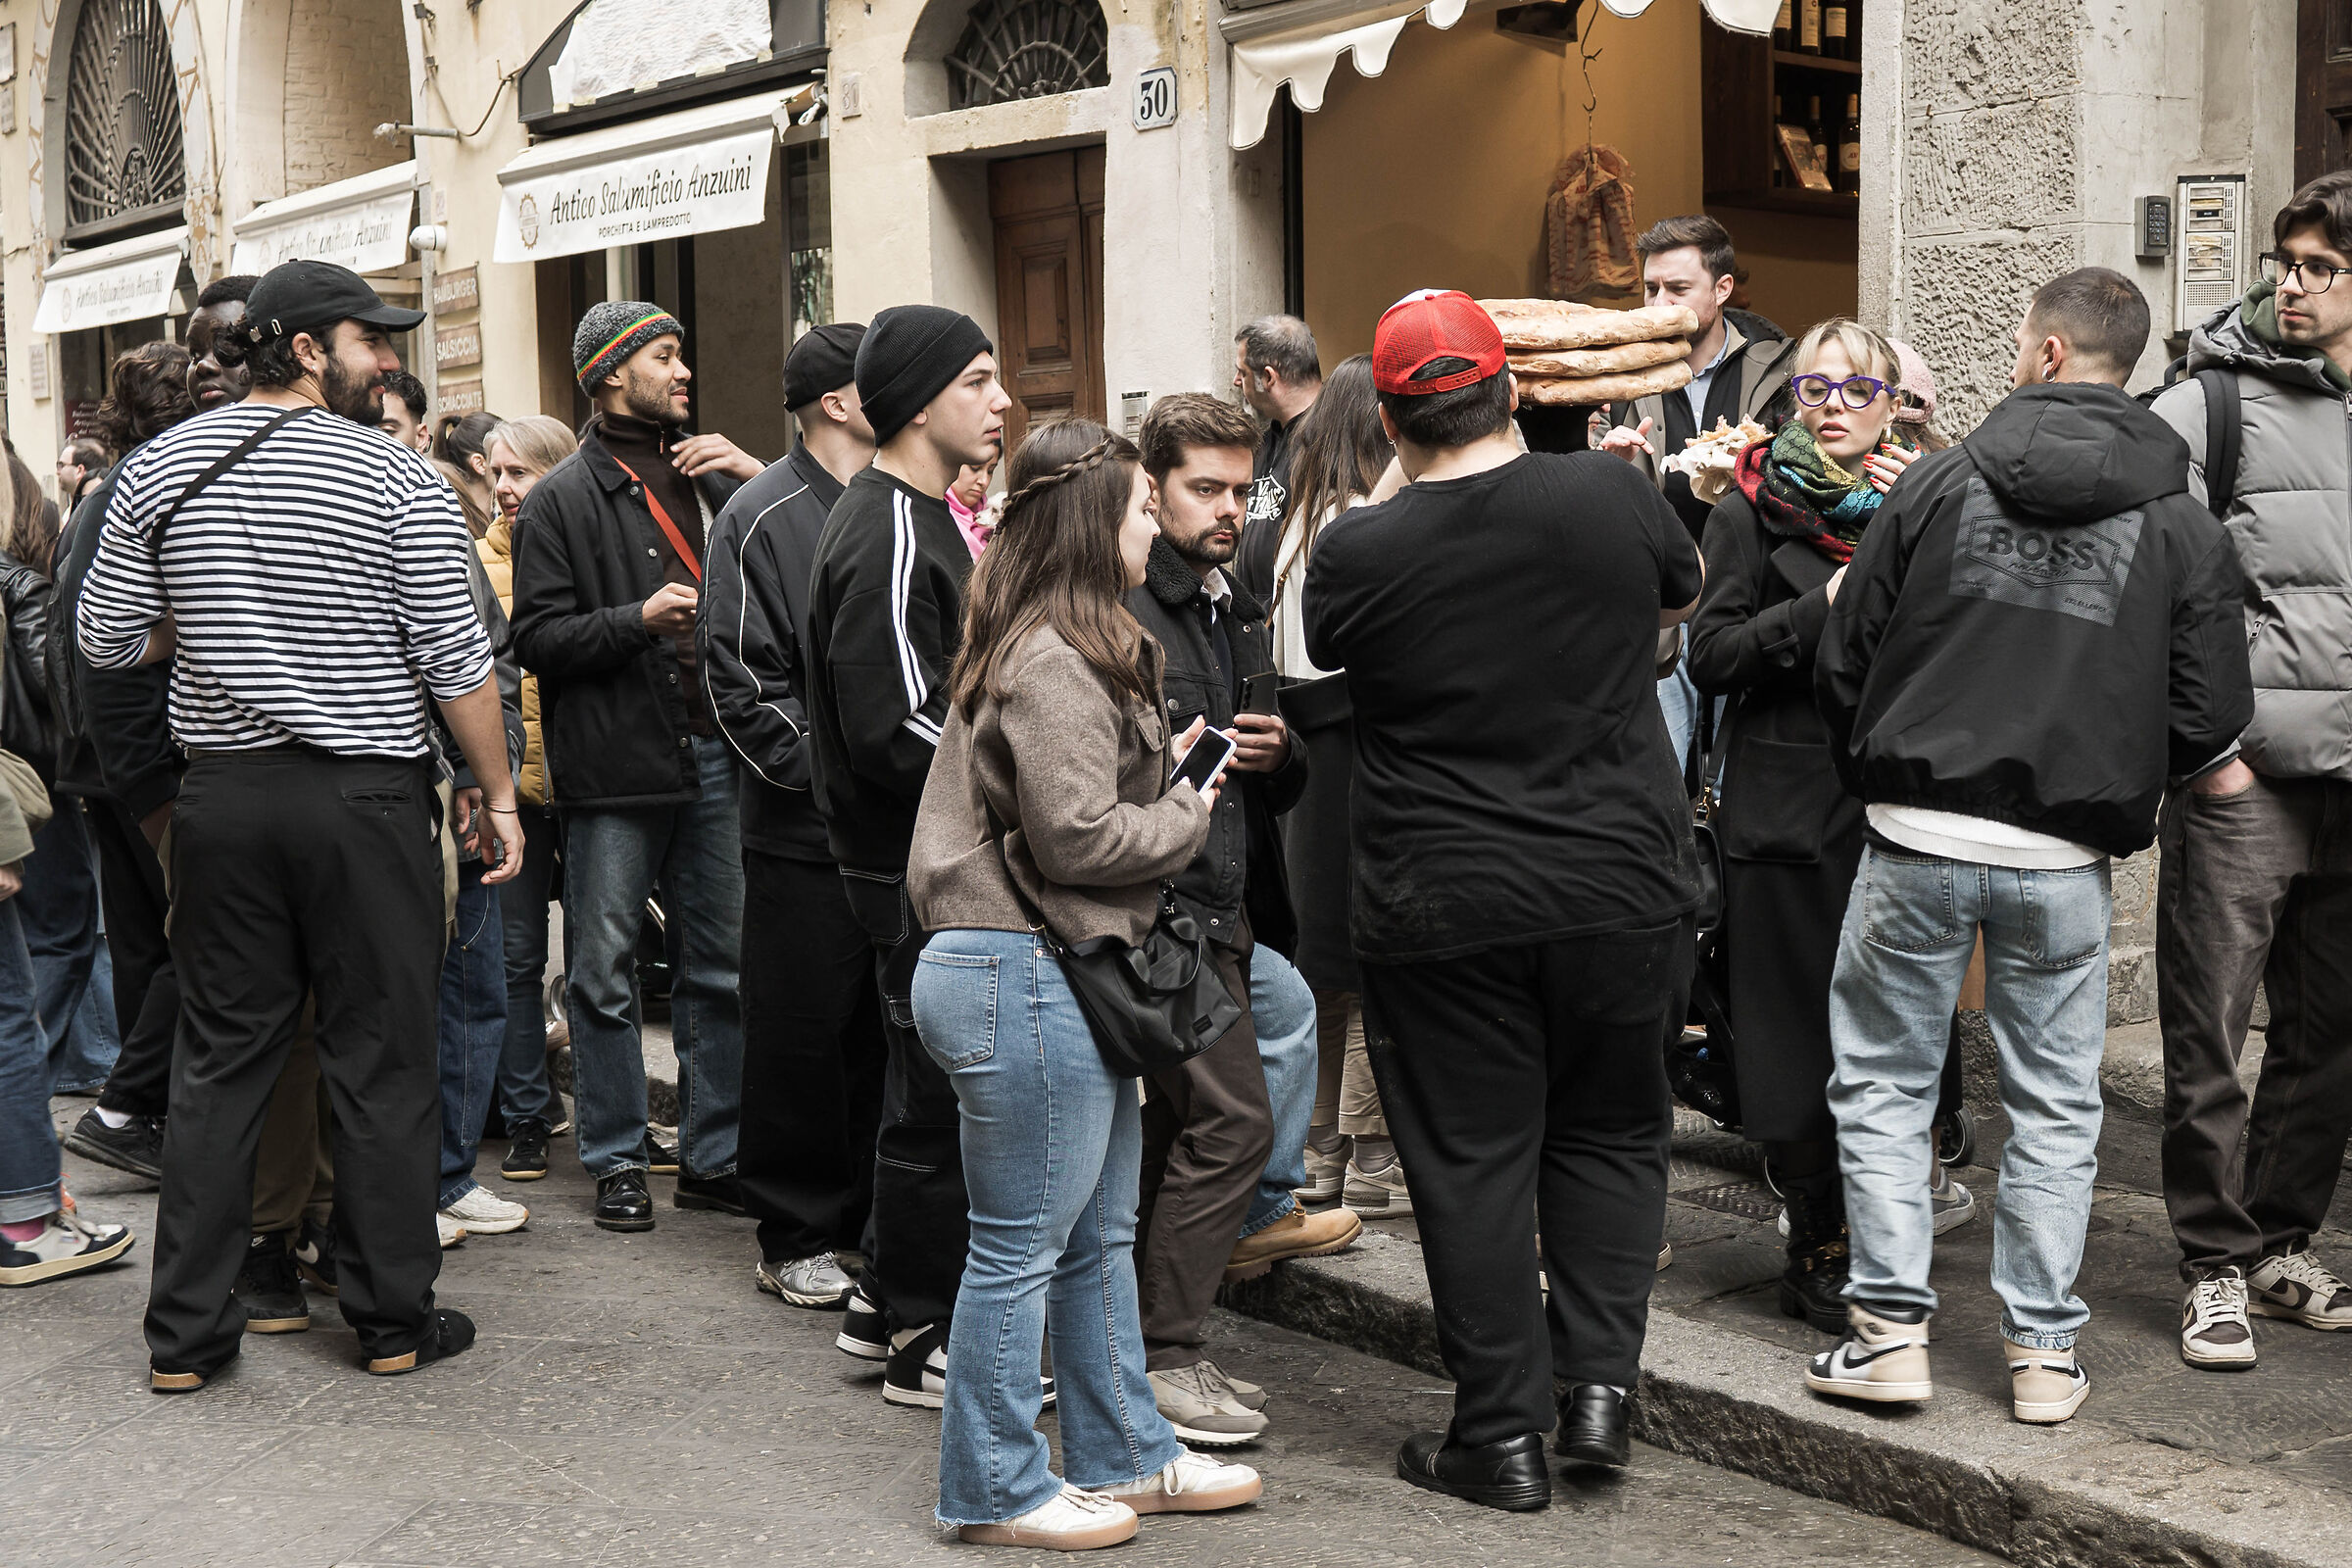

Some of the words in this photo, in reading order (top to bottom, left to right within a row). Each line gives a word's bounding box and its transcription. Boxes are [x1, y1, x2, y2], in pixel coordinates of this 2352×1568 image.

[1140, 77, 1168, 120] 30
[550, 189, 595, 224] Antico
[601, 169, 682, 215] Salumificio
[688, 155, 752, 199] Anzuini
[636, 220, 641, 232] E
[643, 213, 691, 231] LAMPREDOTTO
[433, 277, 477, 304] HAMBURGER
[436, 335, 478, 362] SALSICCIA
[438, 391, 483, 414] SCHIACCIATE
[1987, 525, 2095, 570] BOSS
